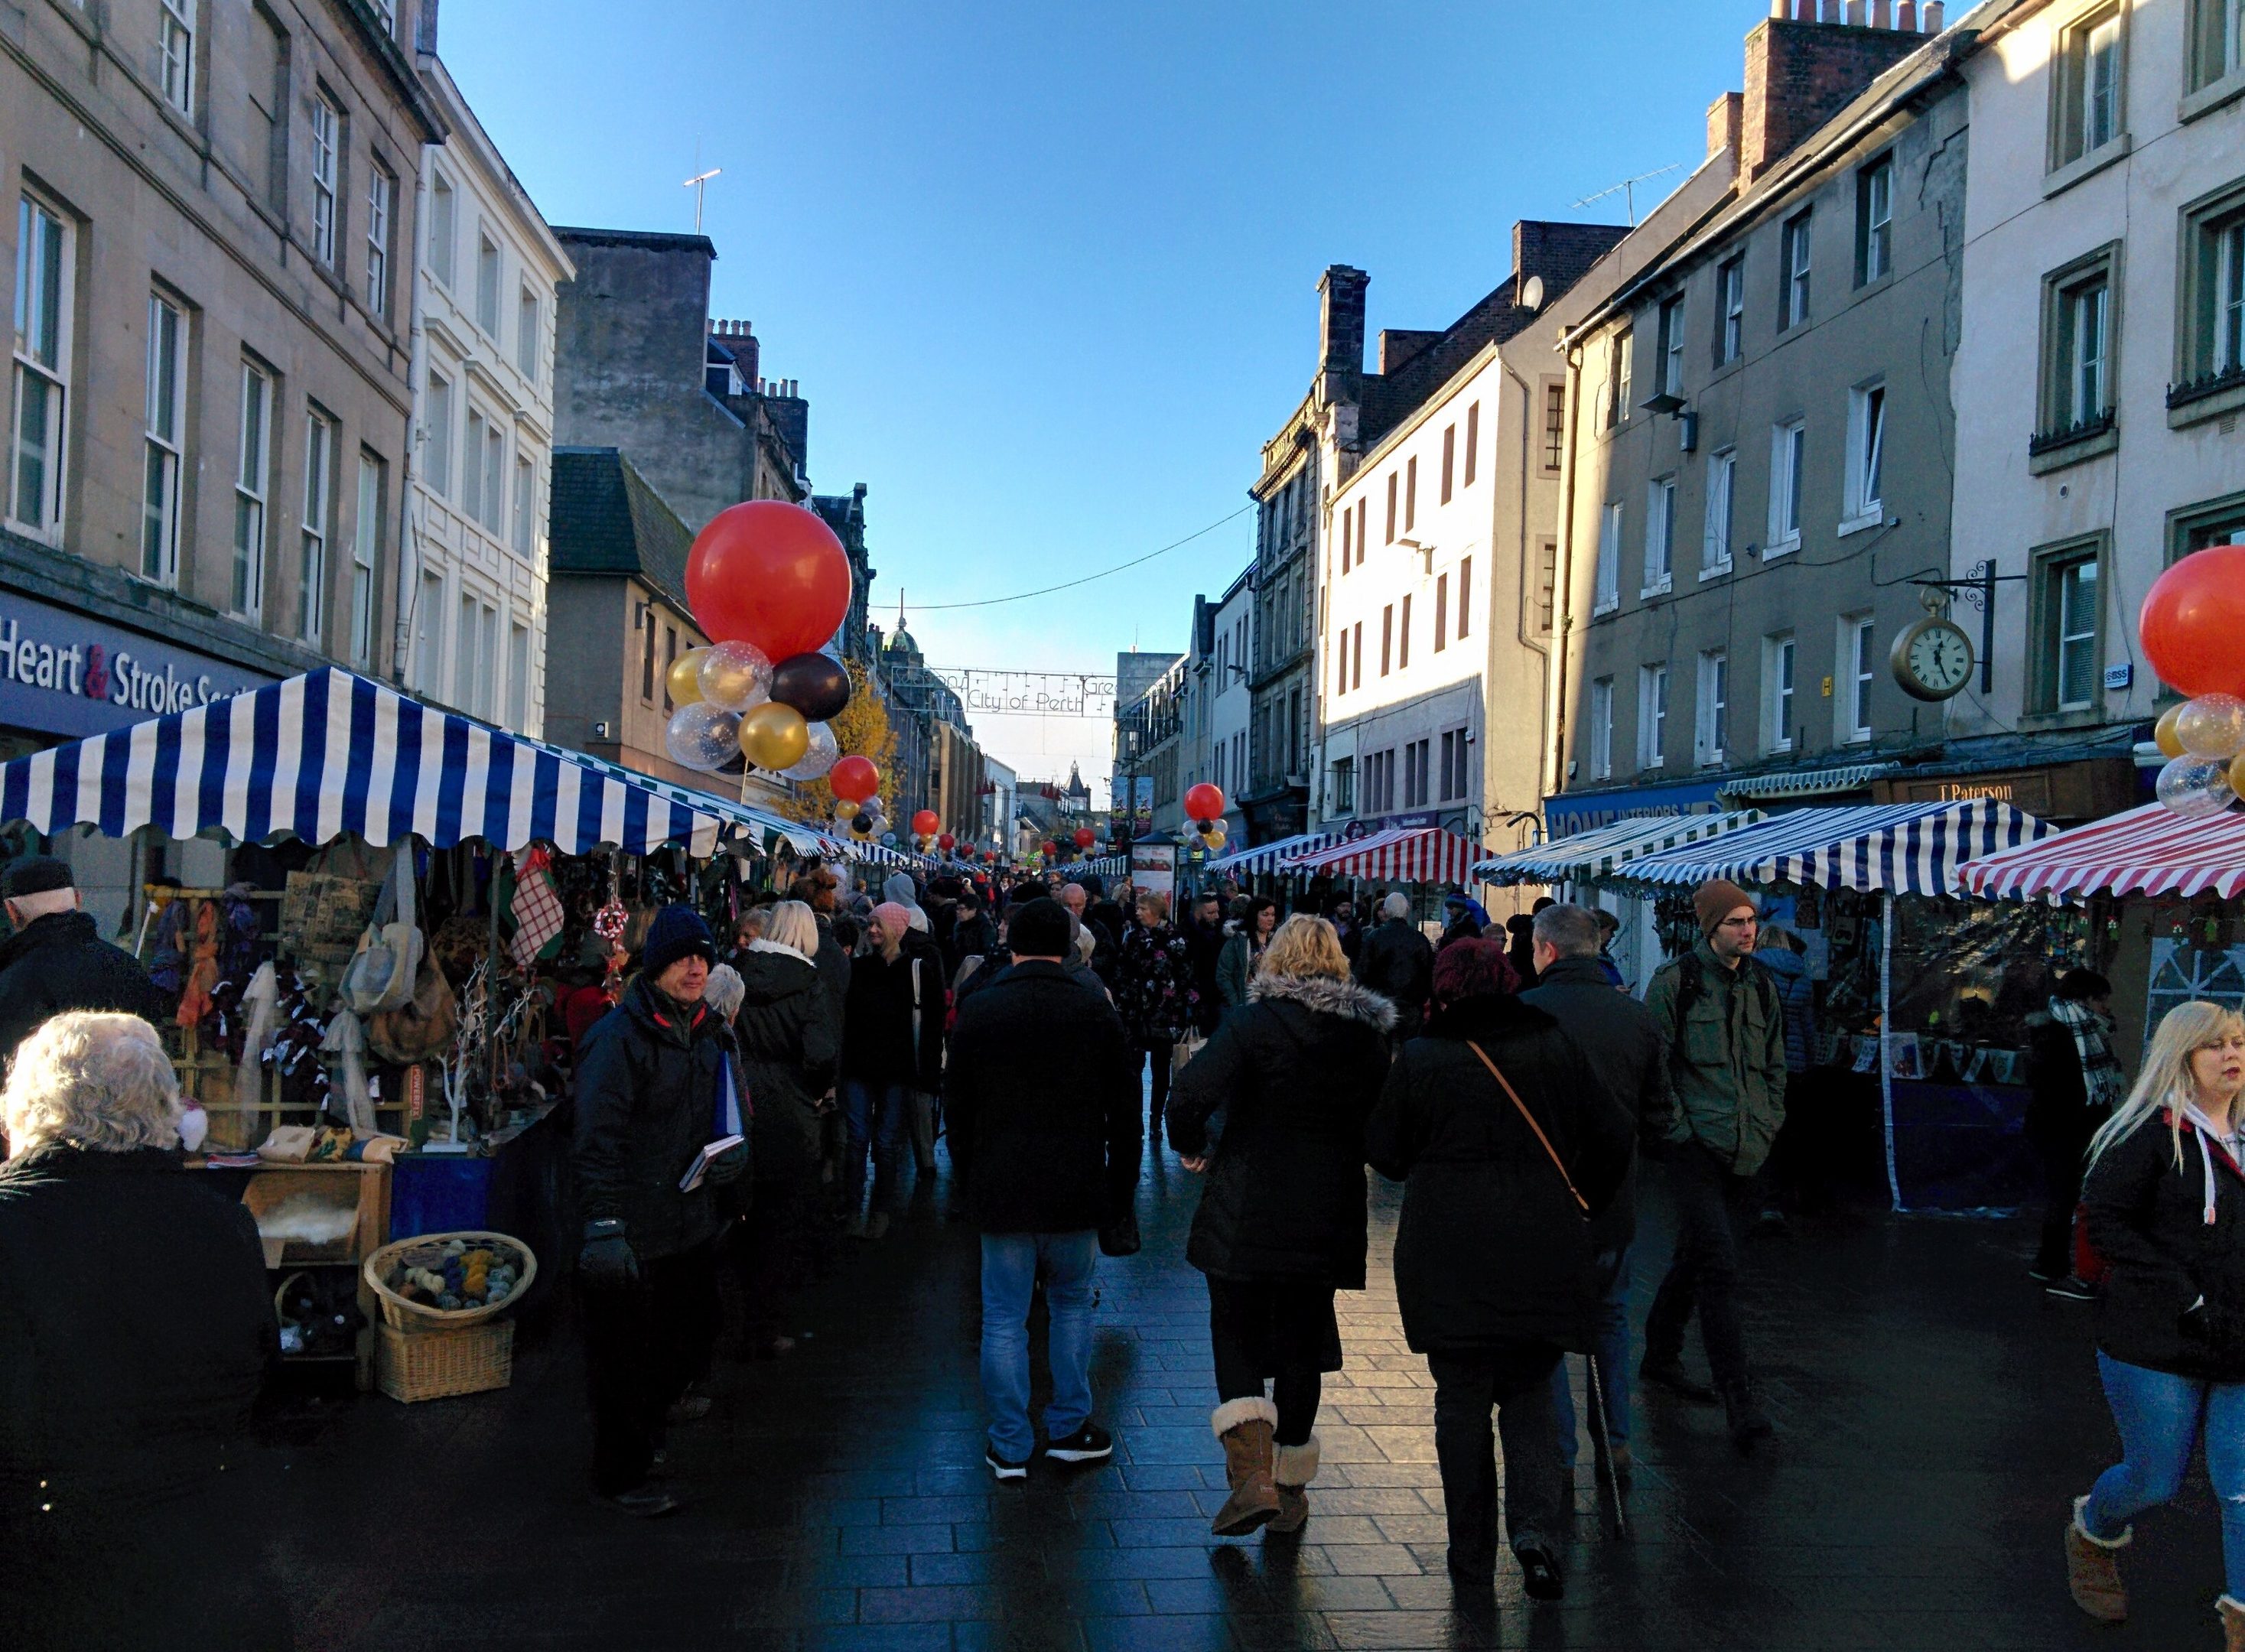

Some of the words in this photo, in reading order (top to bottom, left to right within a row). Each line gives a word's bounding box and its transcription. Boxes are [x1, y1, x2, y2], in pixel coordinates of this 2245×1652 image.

[87, 643, 109, 700] &
[114, 652, 191, 715] Stroke
[968, 689, 1000, 713] City
[1010, 694, 1028, 710] of
[1037, 693, 1082, 712] Perth
[1951, 784, 2012, 802] Paterson
